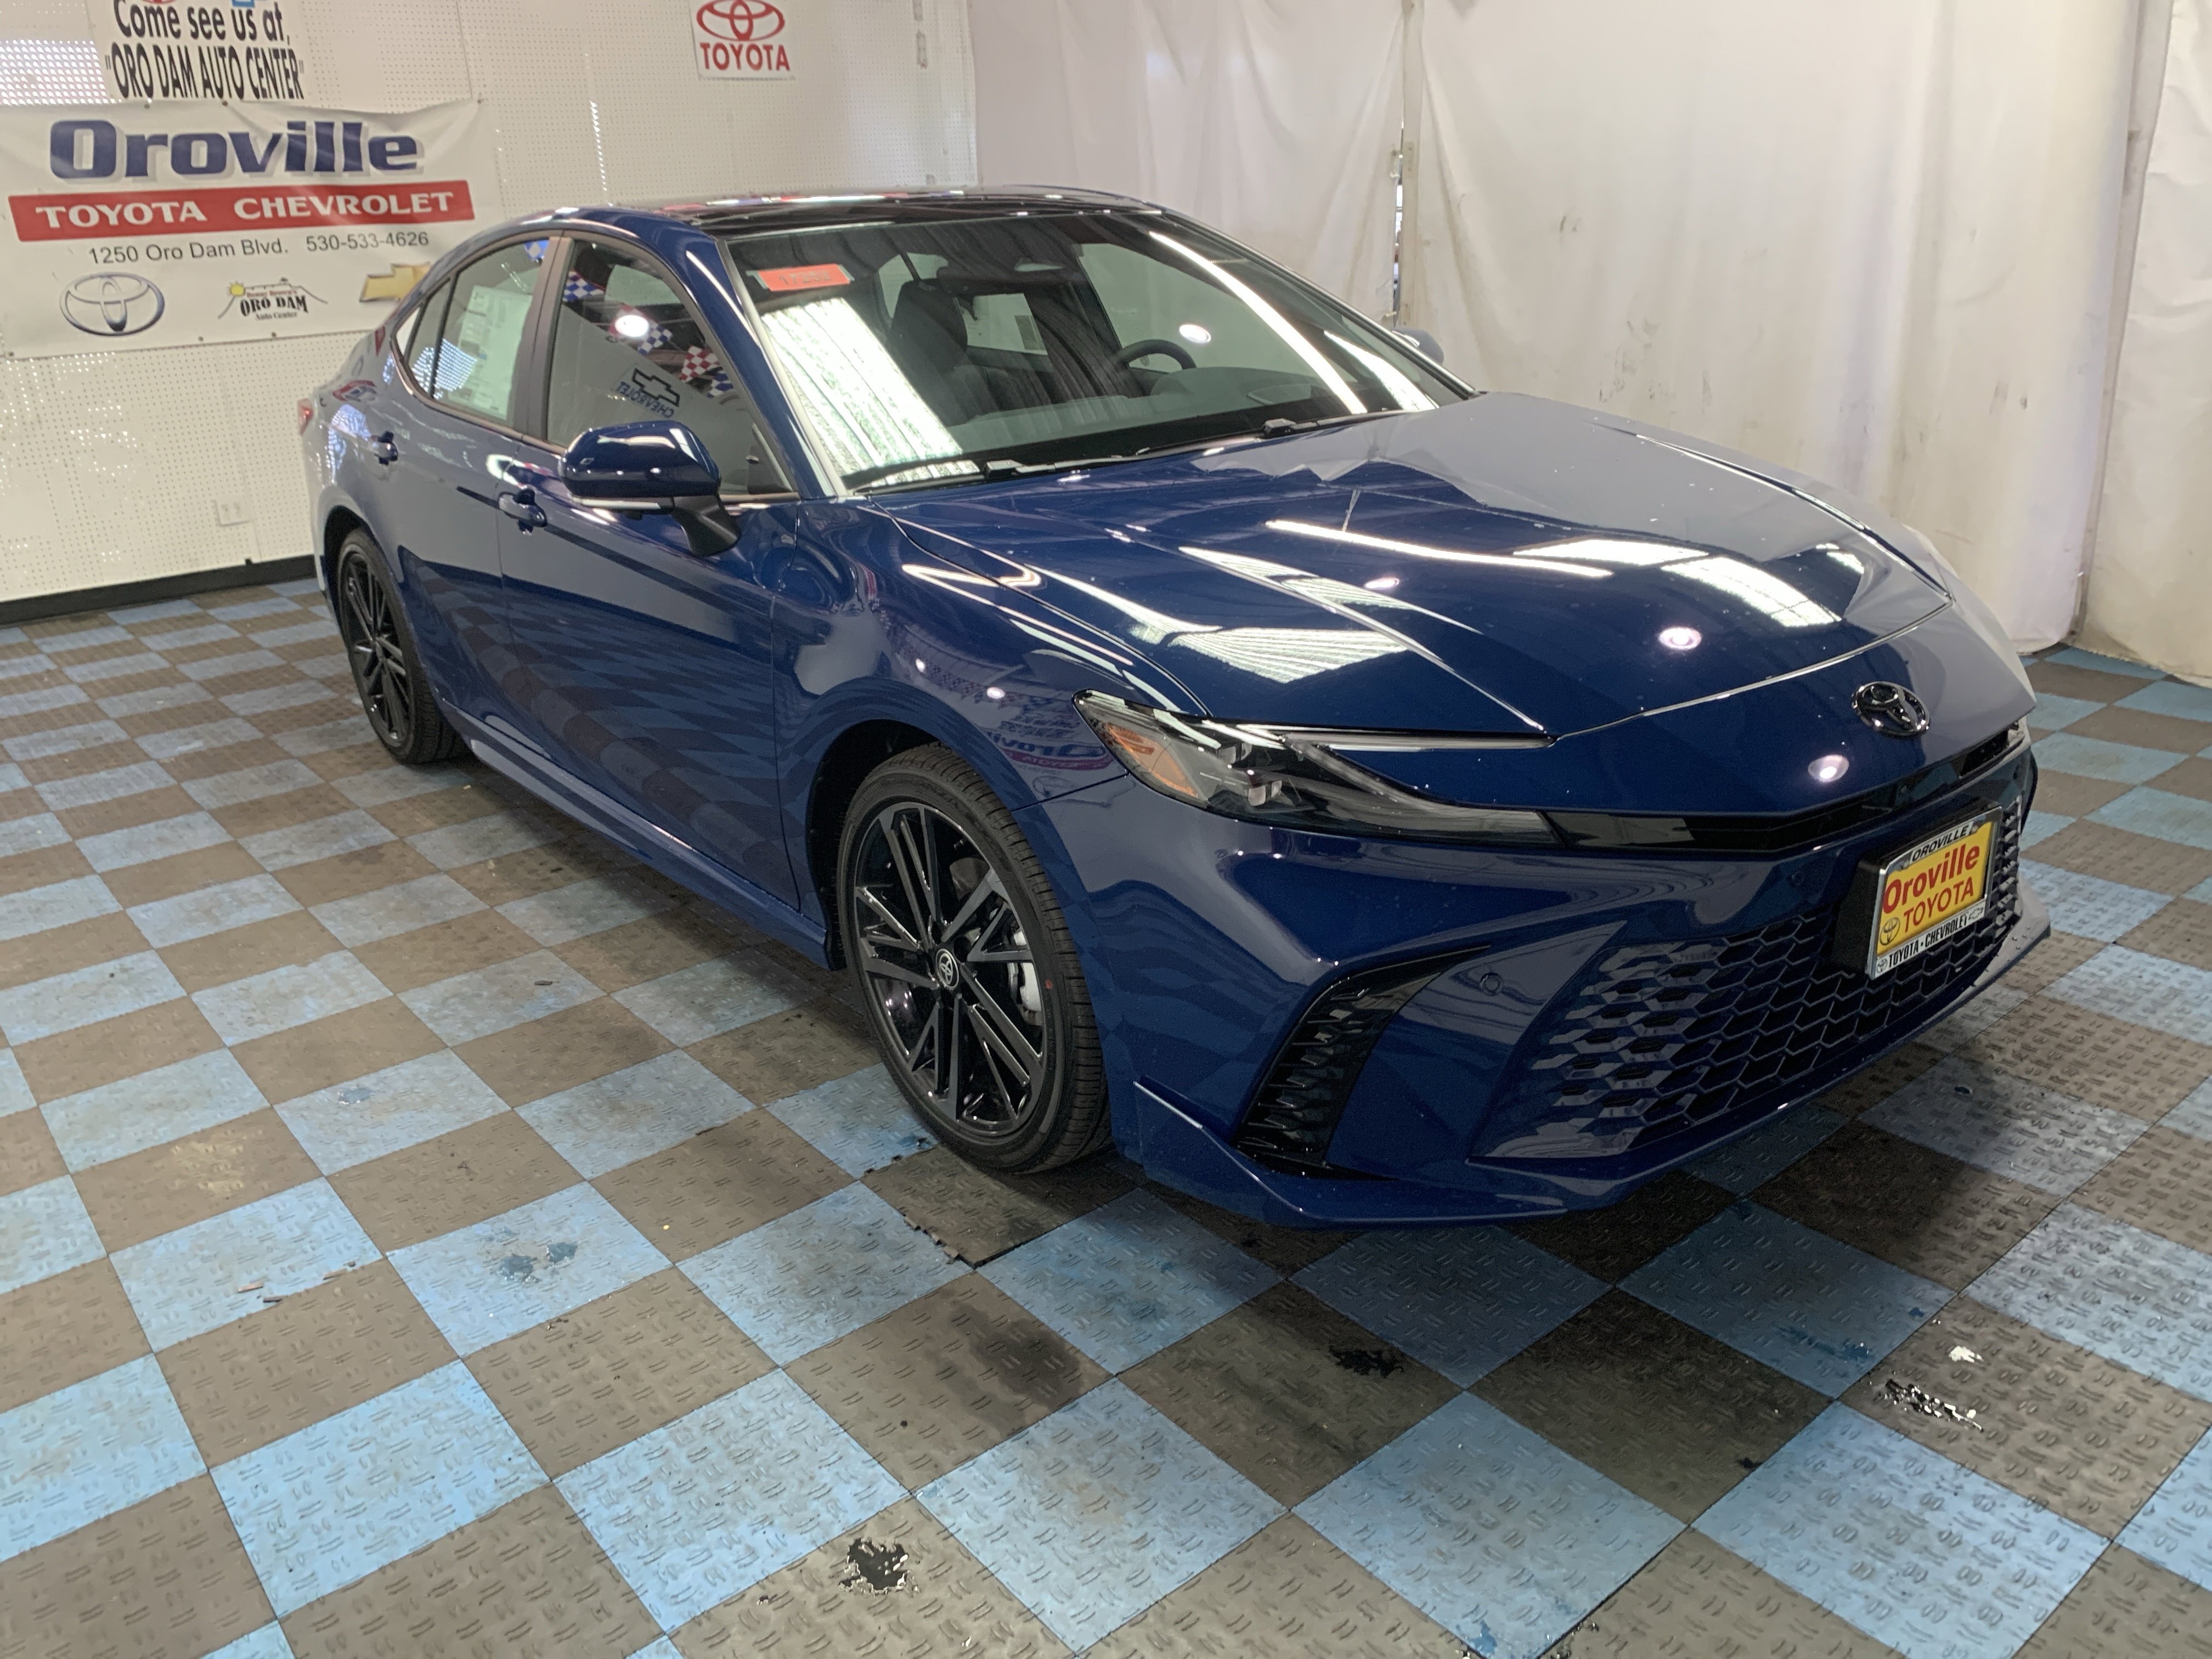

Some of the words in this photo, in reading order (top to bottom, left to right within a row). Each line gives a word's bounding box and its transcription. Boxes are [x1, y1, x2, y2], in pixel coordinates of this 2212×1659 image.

[113, 0, 182, 38] Come
[187, 6, 226, 40] see
[230, 8, 257, 41] us
[153, 44, 199, 98] DAM
[198, 45, 245, 99] AUTO
[699, 42, 791, 71] TOYOTA
[50, 120, 420, 180] Oroville
[36, 201, 207, 228] TOYOTA
[234, 191, 453, 220] CHEVROLET
[89, 245, 139, 265] 1250
[146, 244, 183, 261] Oro
[190, 241, 236, 258] Dam
[242, 238, 289, 256] Blvd.
[306, 232, 430, 252] 530-533-4626
[240, 298, 271, 317] ORO
[275, 295, 309, 313] DAM
[1911, 825, 1970, 862] OROVILLE
[1882, 843, 1980, 914] Oroville
[1903, 876, 1974, 933] TOYOTA
[1888, 941, 1919, 968] TOYOTA
[1925, 913, 1968, 947] CHEVROLET
